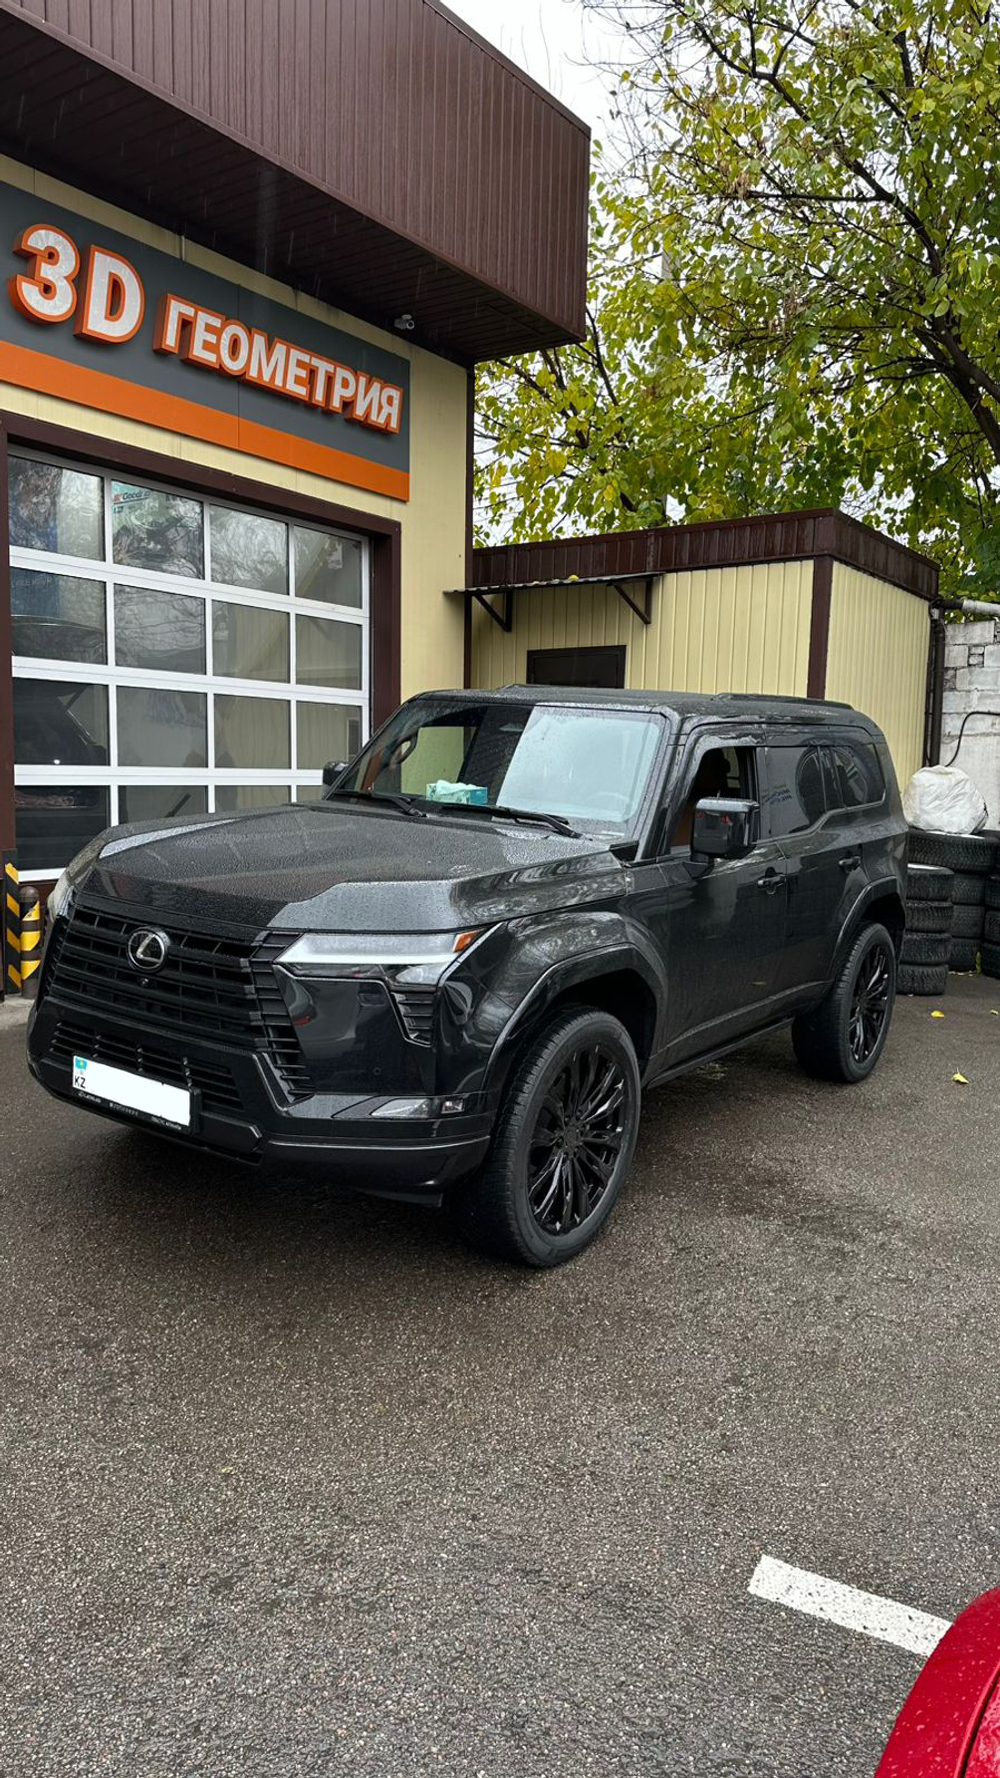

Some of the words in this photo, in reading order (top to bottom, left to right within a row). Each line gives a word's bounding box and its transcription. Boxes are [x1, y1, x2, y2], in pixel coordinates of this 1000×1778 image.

[12, 224, 145, 343] 3D
[156, 294, 403, 434] ГЕОМЕТРИЯ
[74, 1076, 86, 1089] KZ
